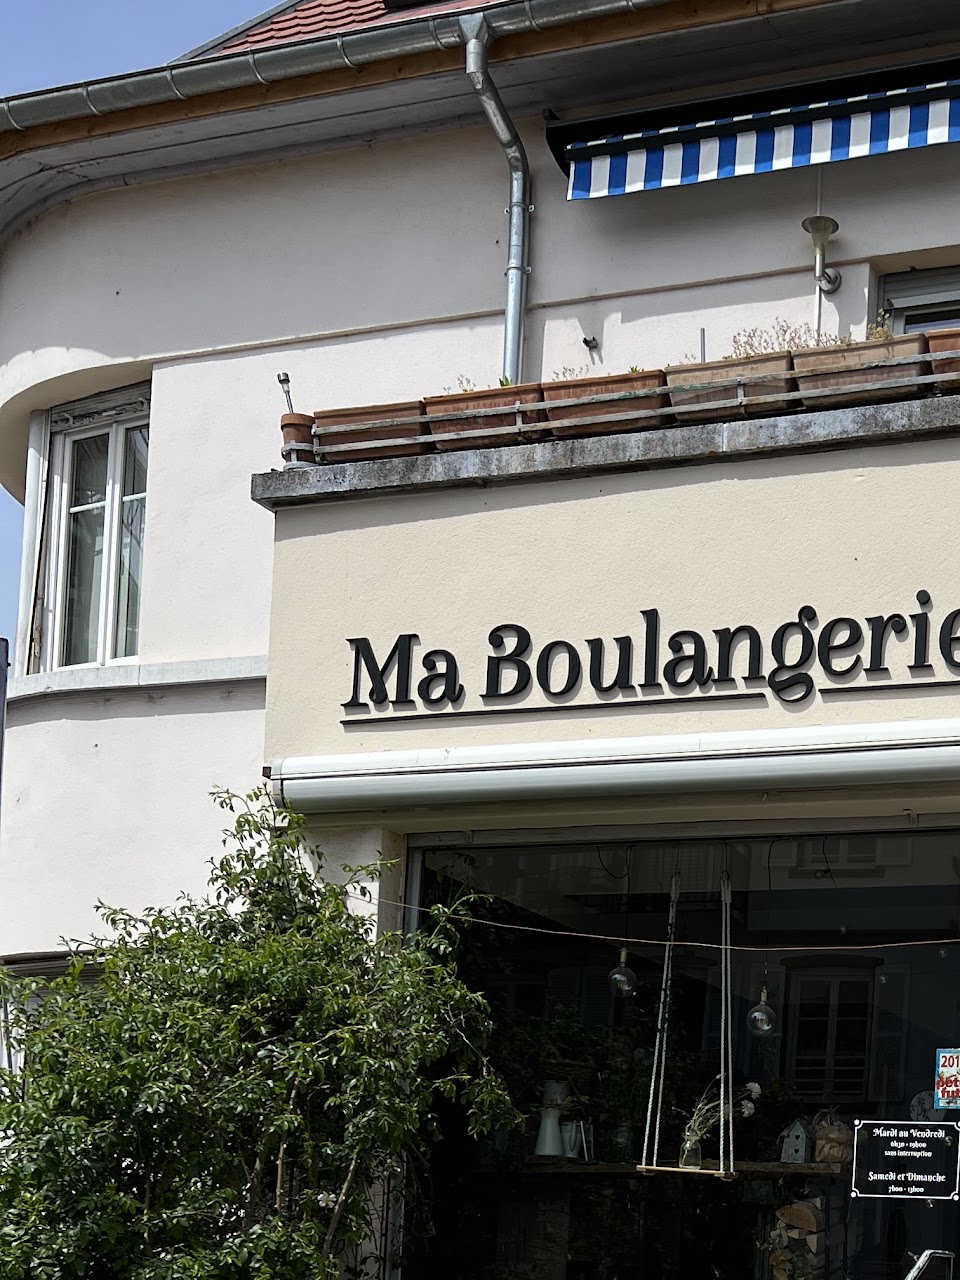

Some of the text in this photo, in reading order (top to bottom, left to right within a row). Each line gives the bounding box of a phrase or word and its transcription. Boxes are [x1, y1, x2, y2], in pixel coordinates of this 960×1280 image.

[341, 633, 464, 708] Ma
[873, 1127, 945, 1138] Mardi au Vendredi
[897, 1150, 932, 1158] interruption
[868, 1171, 946, 1182] Samedi et Dimanche
